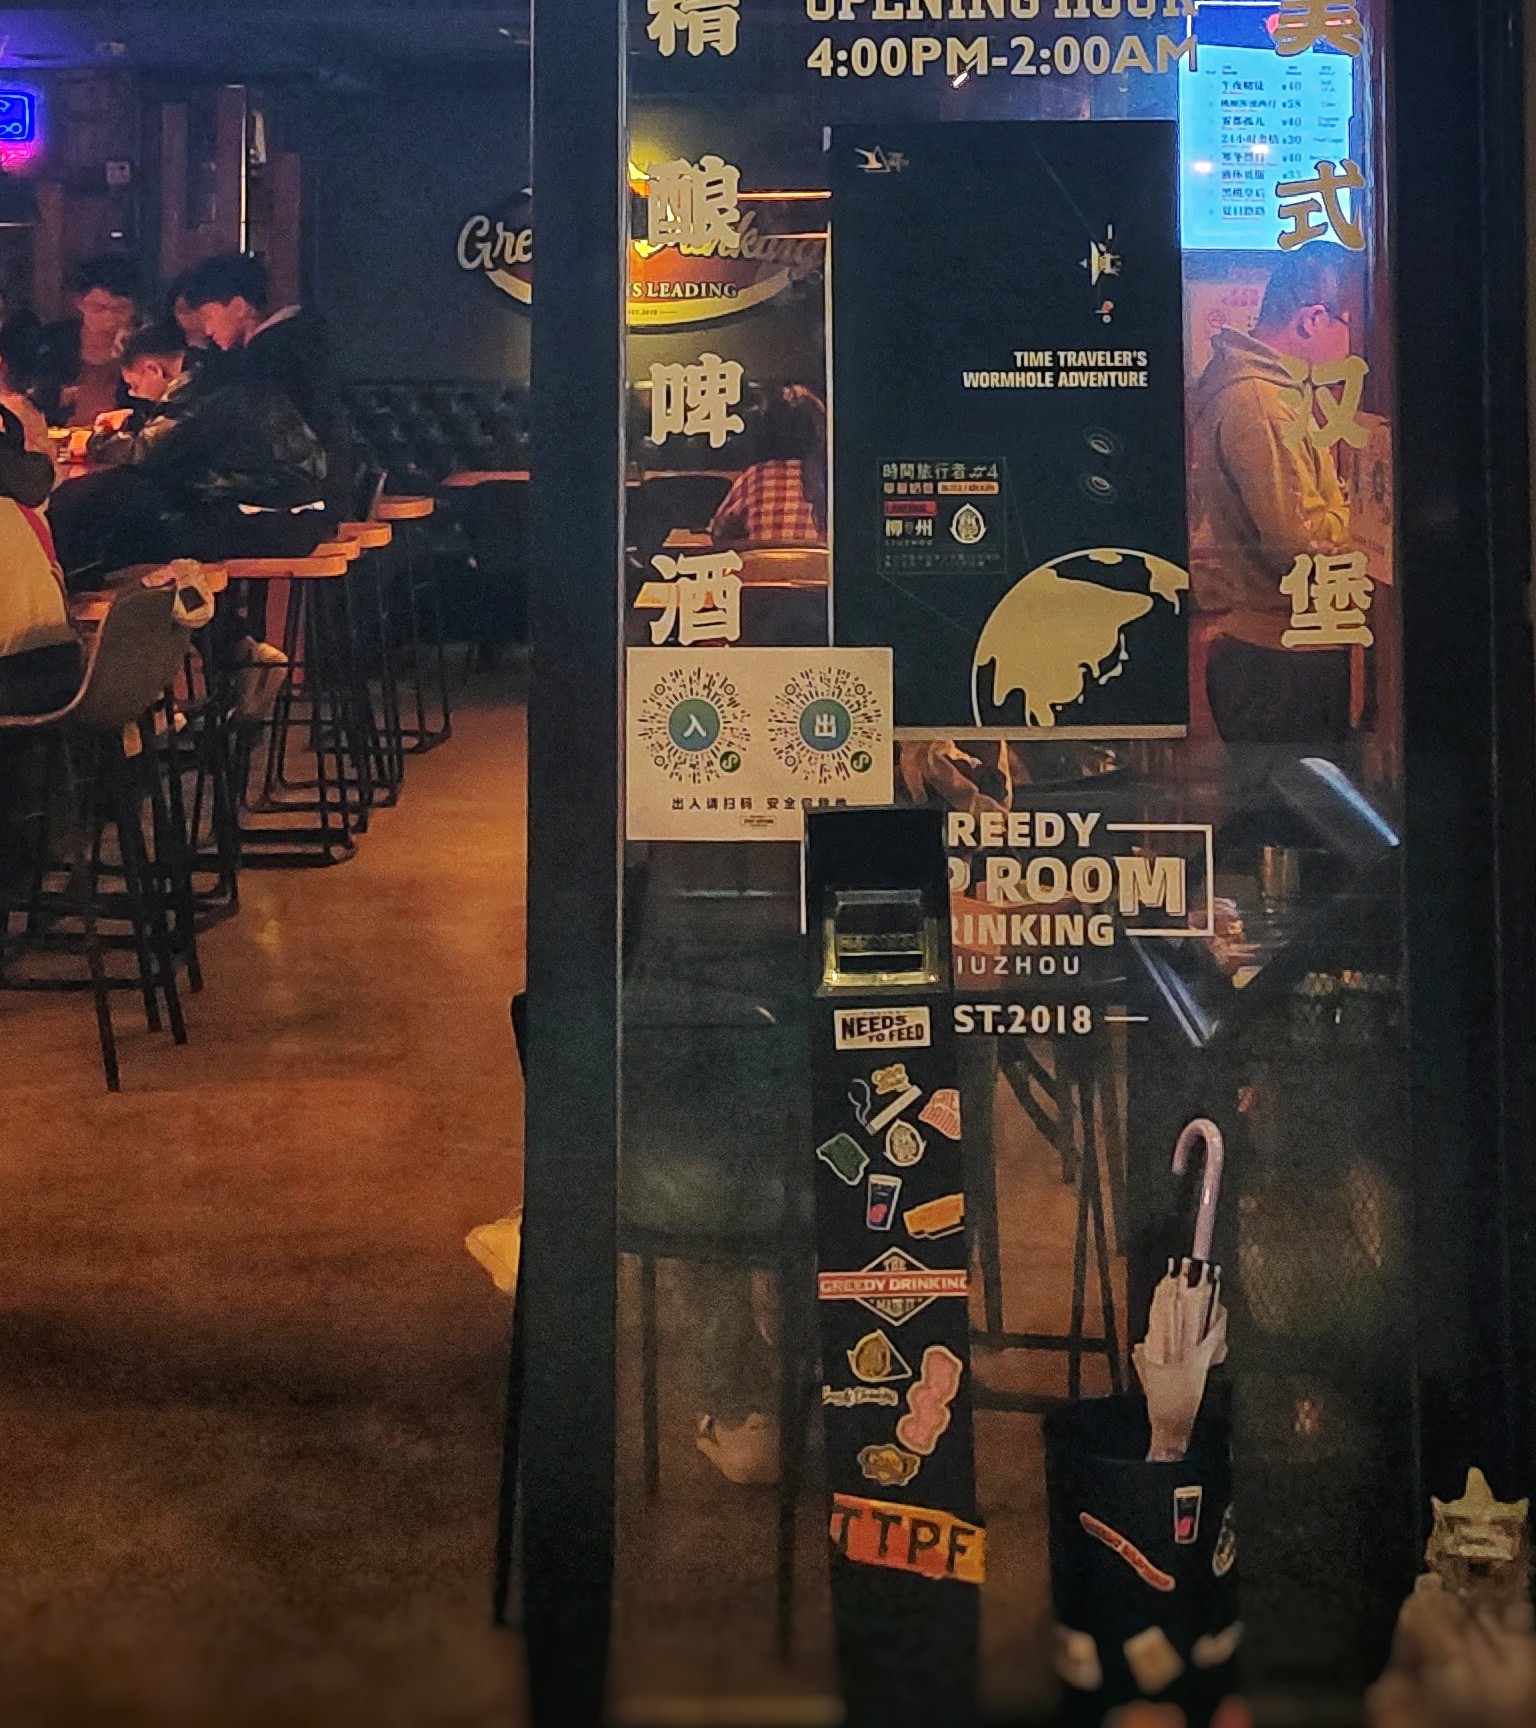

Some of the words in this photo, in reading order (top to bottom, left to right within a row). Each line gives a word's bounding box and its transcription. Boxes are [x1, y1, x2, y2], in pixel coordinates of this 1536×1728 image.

[806, 35, 1198, 77] 4:00PM-2:00AM
[647, 282, 739, 298] LEADING
[1014, 351, 1054, 367] TIME
[1057, 351, 1148, 367] TRAVELER'S
[963, 371, 1054, 388] WORMHOLE
[1057, 371, 1148, 387] ADVENTURE
[815, 713, 837, 738] 出
[948, 812, 1101, 849] REEDY
[986, 856, 1187, 917] ROOM
[951, 913, 1115, 948] RINKING
[957, 955, 1080, 975] IUZHOU
[841, 1016, 907, 1041] NEEDS
[953, 1004, 1093, 1035] ST.2018
[867, 1031, 886, 1043] TO
[888, 1023, 924, 1042] FEED
[819, 1278, 887, 1293] GREEDY
